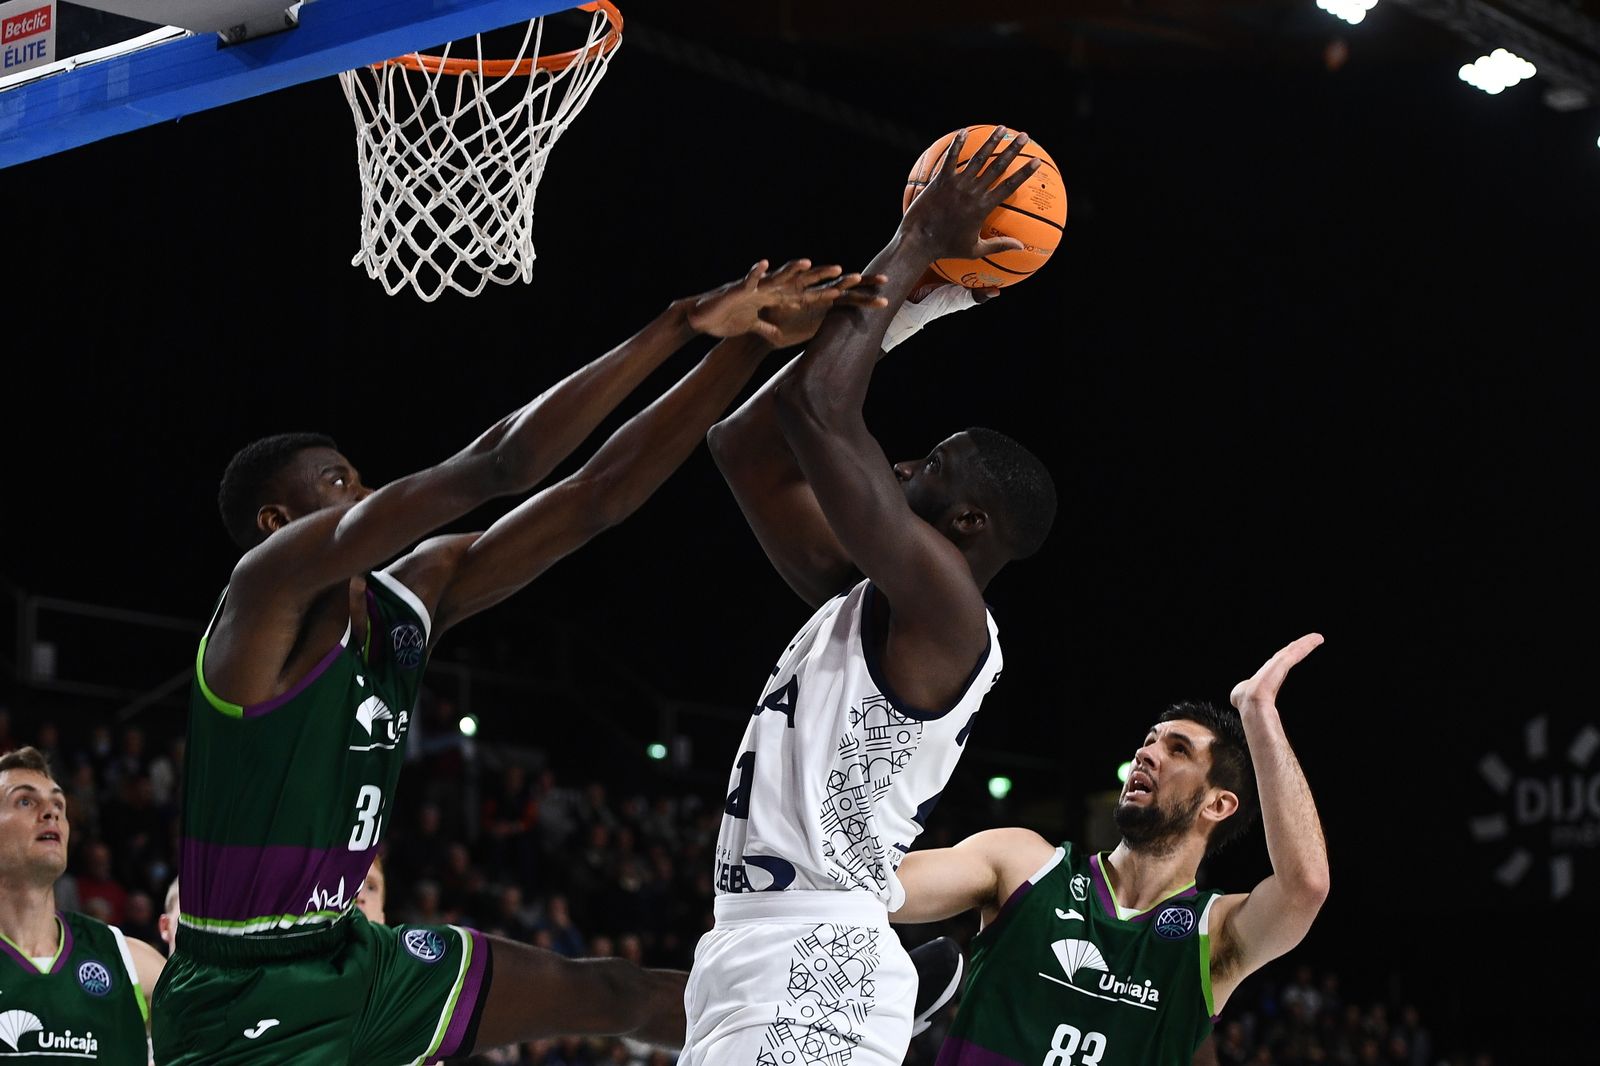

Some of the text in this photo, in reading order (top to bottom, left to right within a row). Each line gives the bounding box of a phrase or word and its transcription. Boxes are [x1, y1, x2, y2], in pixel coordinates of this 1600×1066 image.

[5, 13, 47, 39] Betclic
[4, 39, 46, 68] ÉLITE
[348, 784, 386, 851] 3
[38, 1030, 98, 1054] Unicaja
[1042, 1023, 1107, 1066] 83
